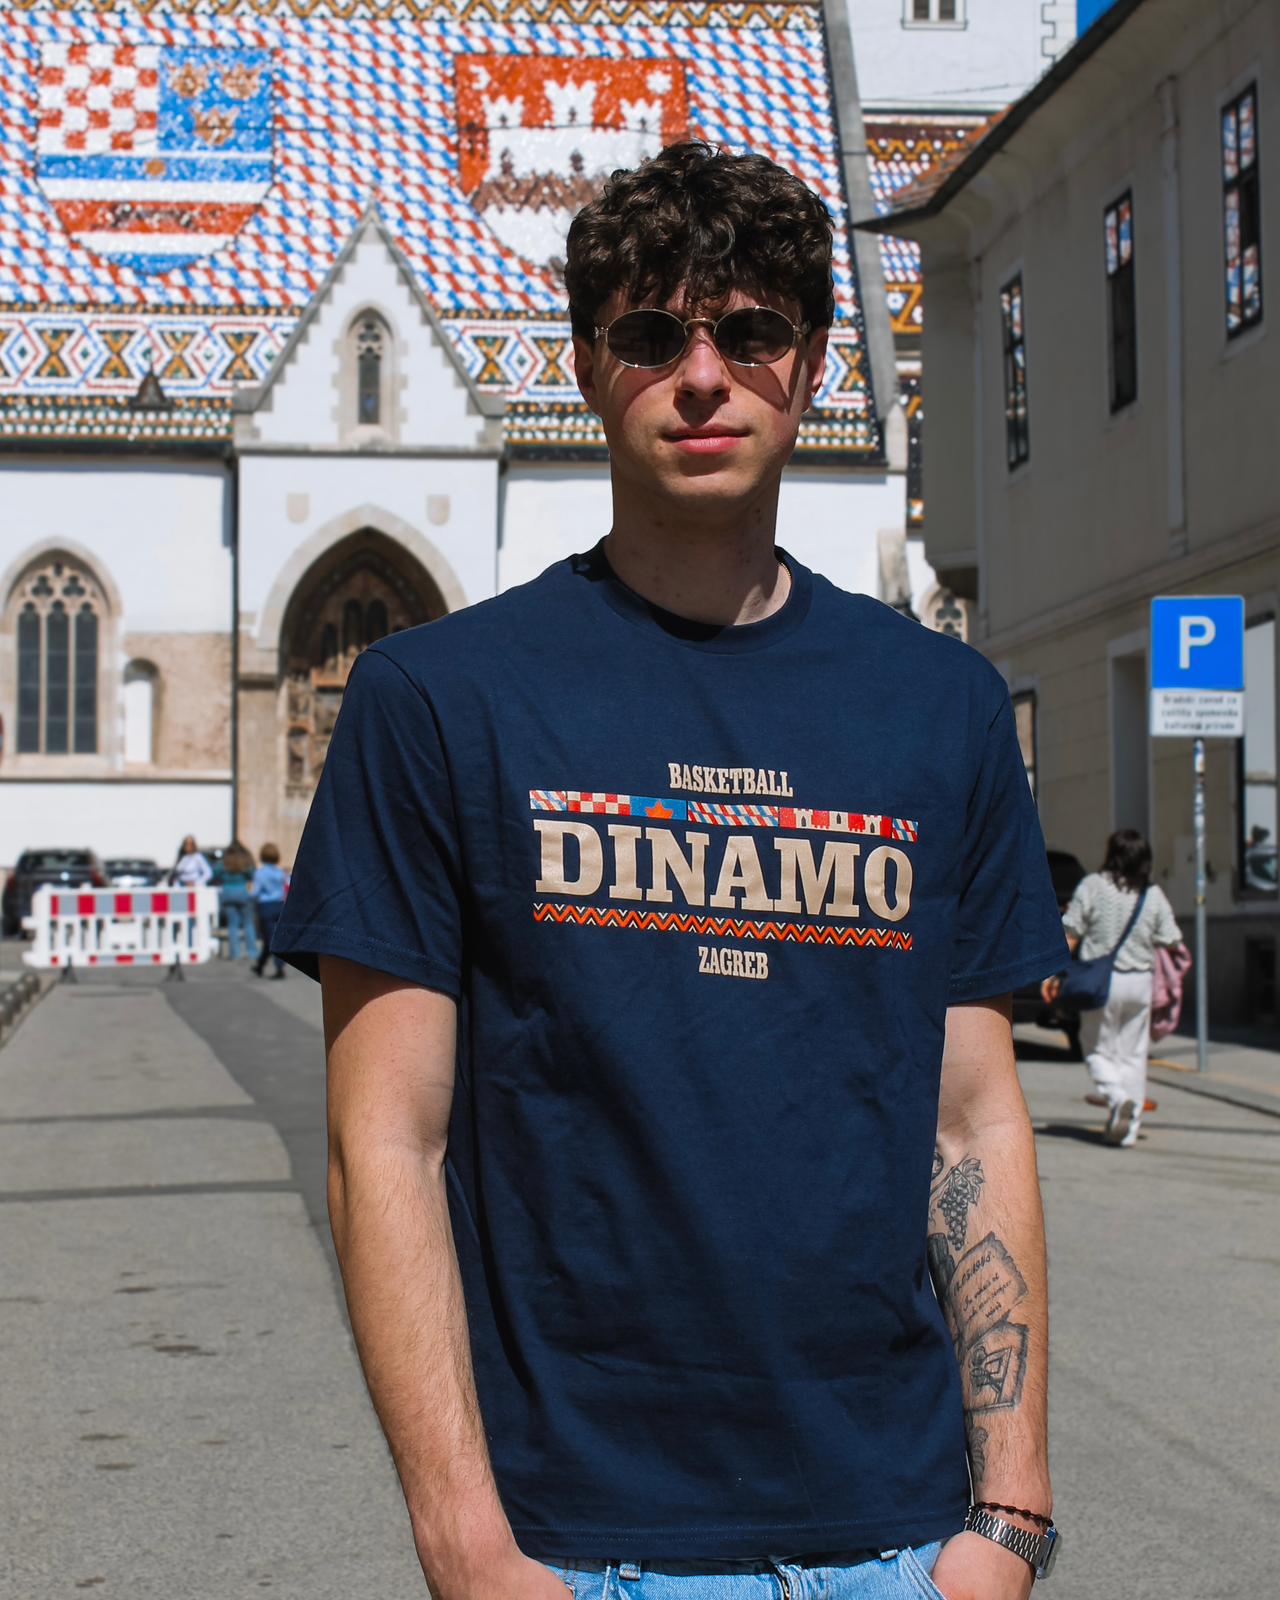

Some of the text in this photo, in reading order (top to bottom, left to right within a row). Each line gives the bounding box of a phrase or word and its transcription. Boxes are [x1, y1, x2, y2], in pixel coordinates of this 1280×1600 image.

[1179, 615, 1216, 668] P
[668, 763, 794, 797] BASKETBALL
[533, 819, 913, 922] DINAMO
[698, 946, 769, 979] ZAGREB
